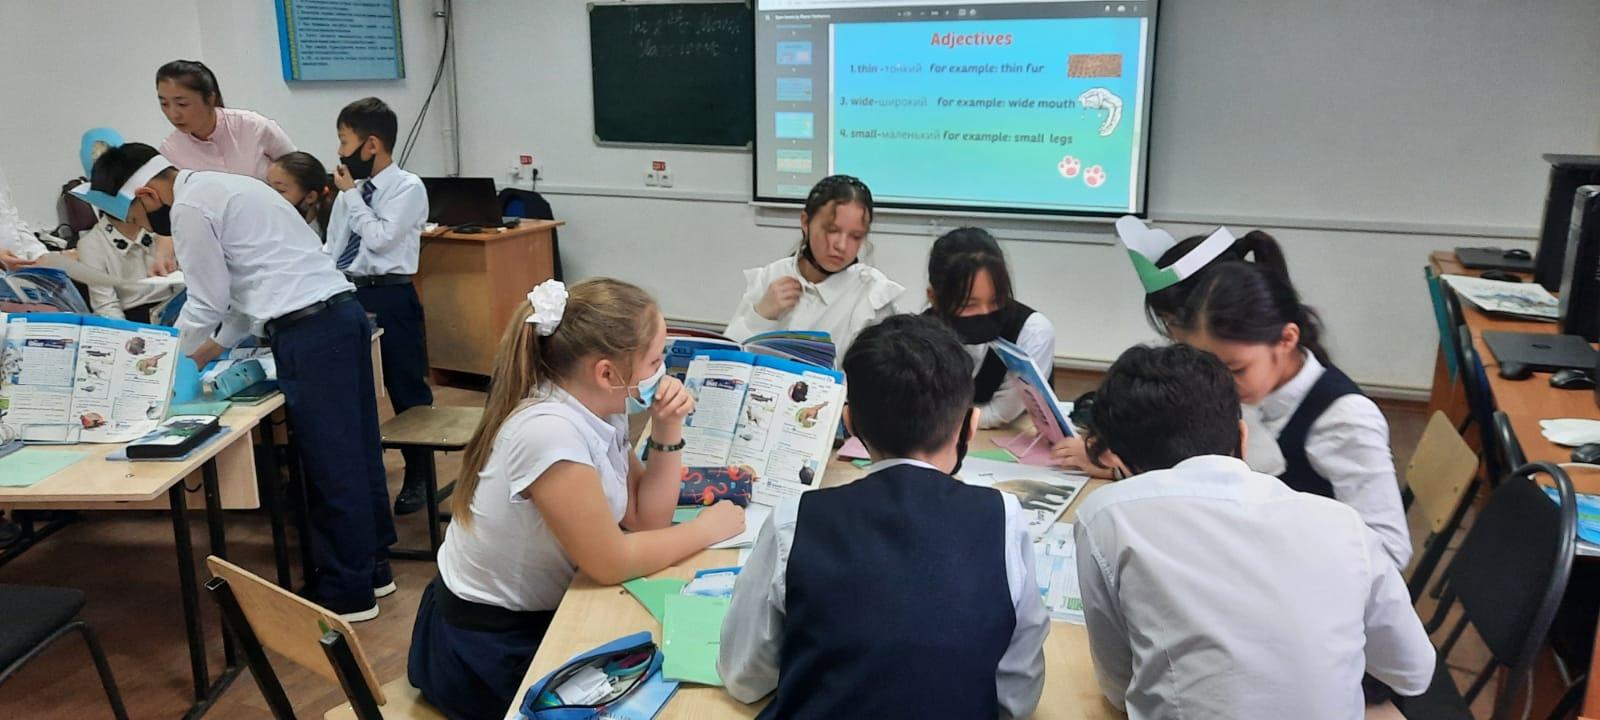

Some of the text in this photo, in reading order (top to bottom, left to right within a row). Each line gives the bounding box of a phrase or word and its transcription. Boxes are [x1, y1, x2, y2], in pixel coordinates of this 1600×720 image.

[930, 32, 1013, 48] Adjectives
[930, 62, 947, 73] for
[949, 63, 998, 76] example:
[1001, 63, 1023, 73] thin
[1026, 62, 1045, 73] fur
[937, 96, 954, 107] for
[957, 97, 1005, 109] example:
[1008, 98, 1035, 108] wide
[1038, 98, 1076, 109] mouth
[943, 130, 960, 141] for
[962, 131, 1011, 143] example:
[1014, 132, 1044, 143] small
[1050, 133, 1073, 146] legs
